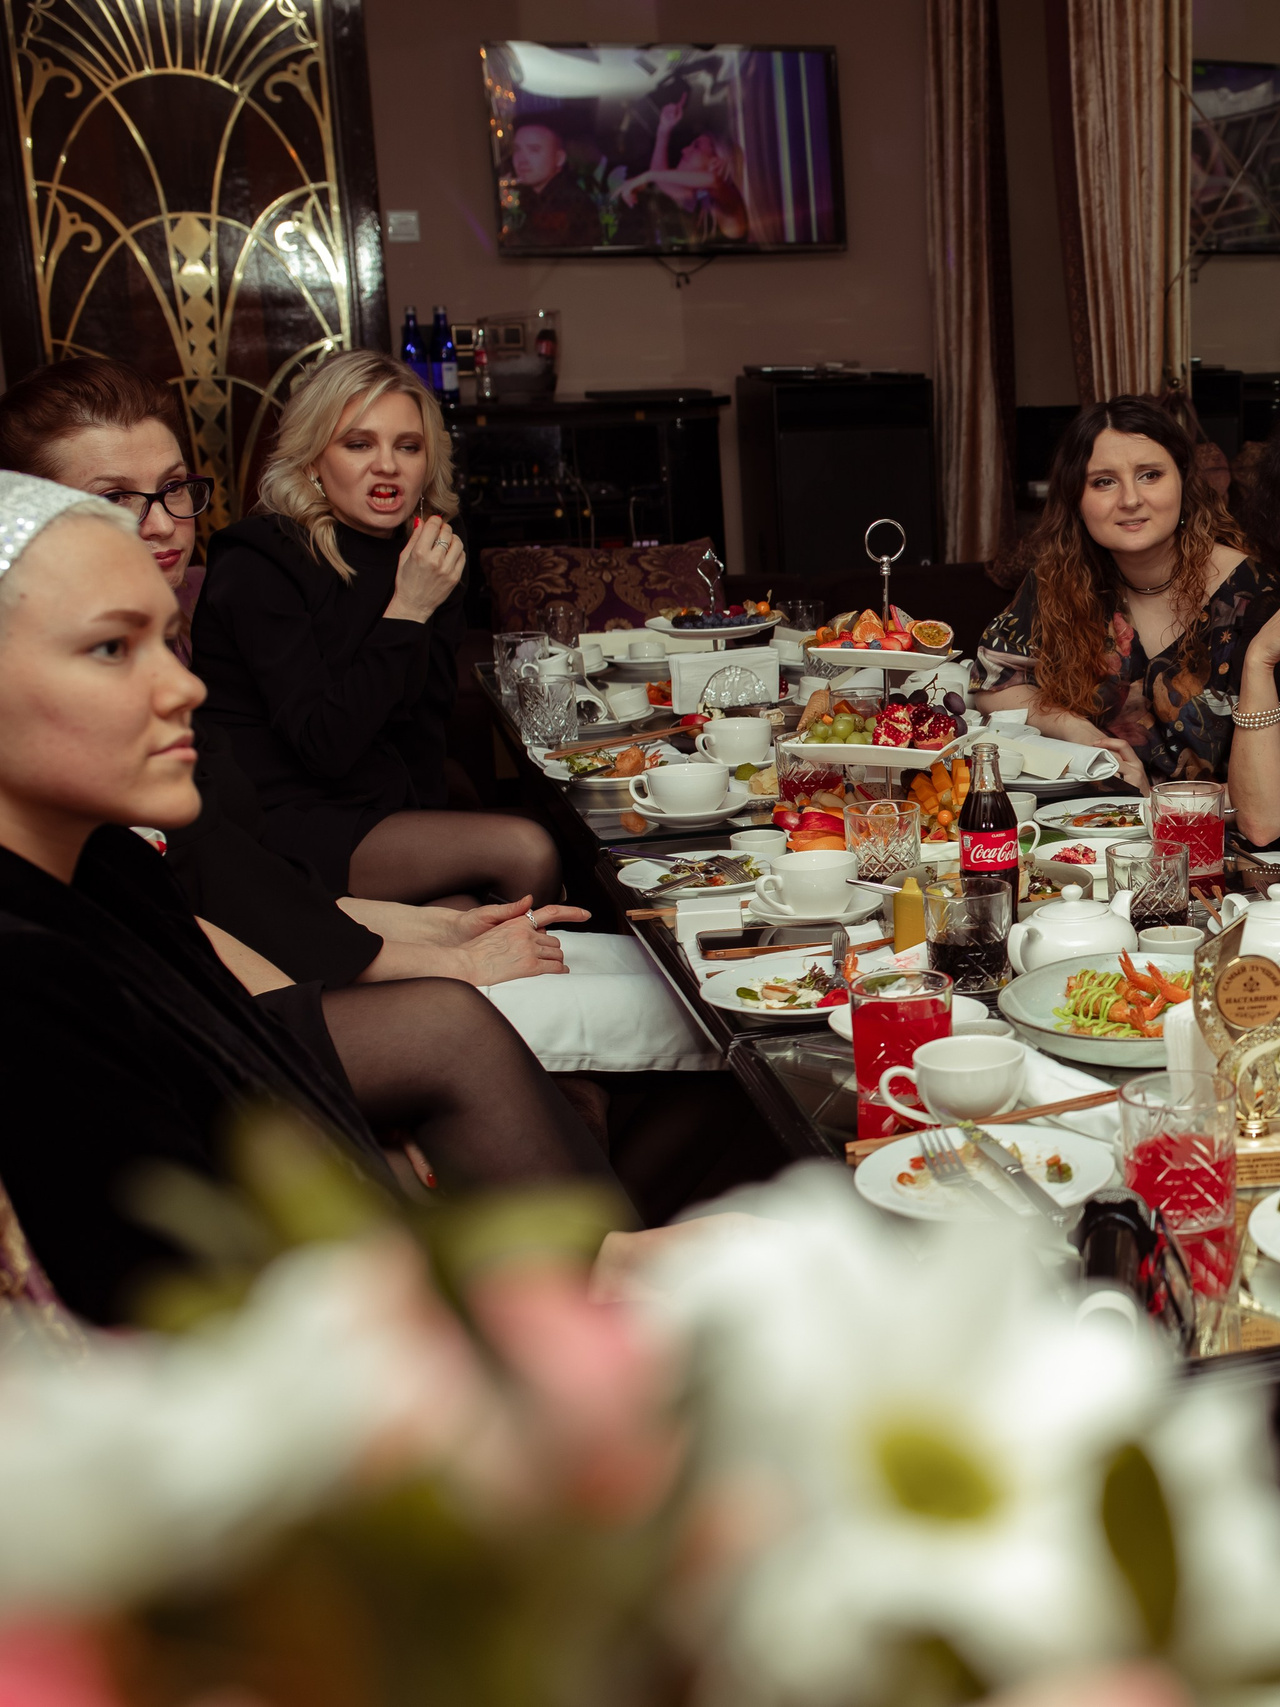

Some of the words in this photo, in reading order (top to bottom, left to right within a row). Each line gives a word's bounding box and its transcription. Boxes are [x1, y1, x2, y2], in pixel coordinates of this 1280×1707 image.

[1222, 966, 1246, 991] САМЫЙ
[1250, 965, 1280, 987] ЛУЧШИЙ
[1225, 995, 1278, 1004] НАСТАВНИК
